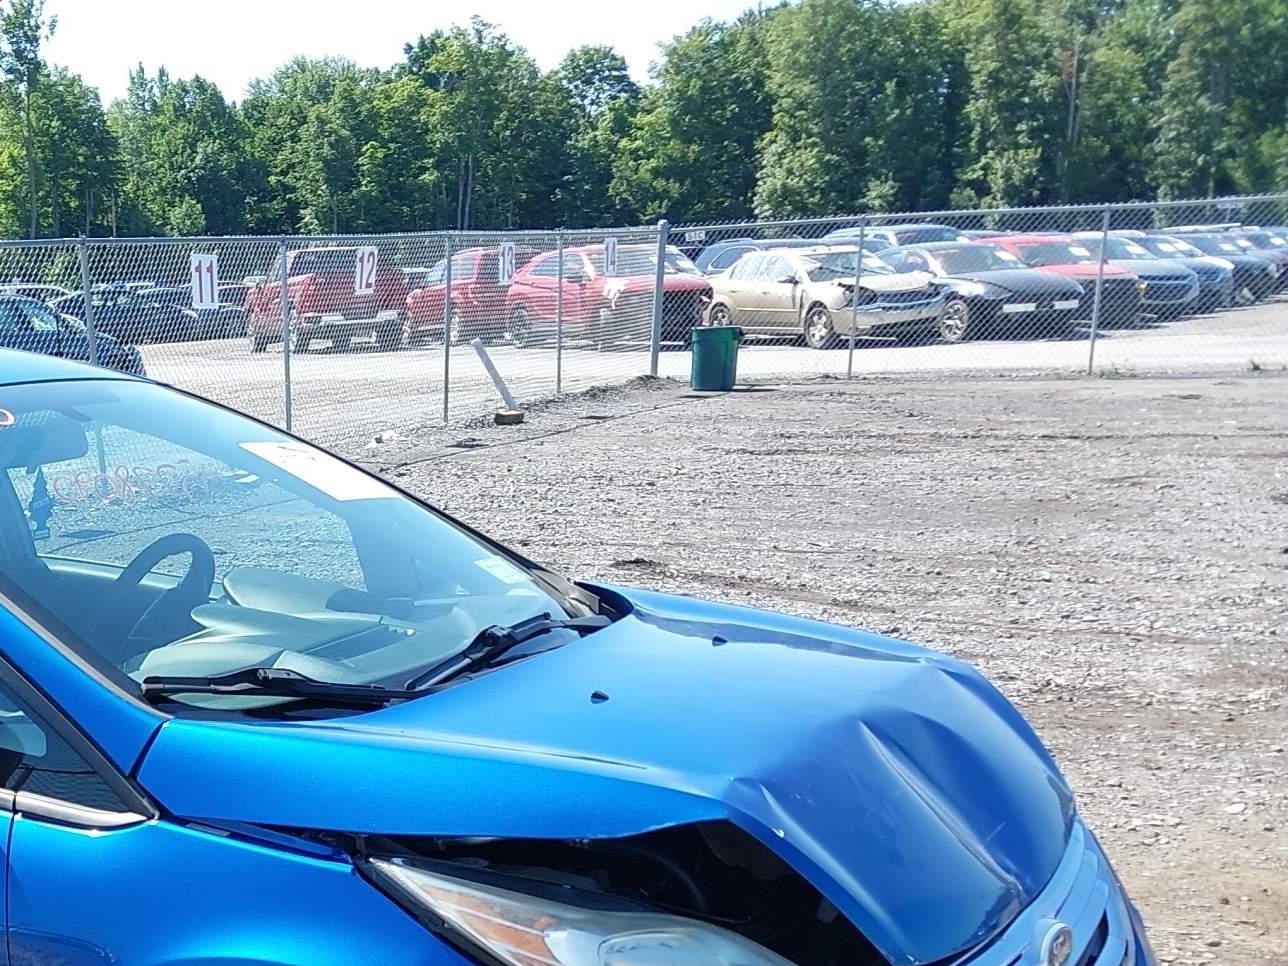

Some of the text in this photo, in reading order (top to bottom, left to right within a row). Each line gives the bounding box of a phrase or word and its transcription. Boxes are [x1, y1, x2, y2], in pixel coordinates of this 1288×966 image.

[194, 259, 214, 303] 11
[358, 251, 376, 290] 12
[500, 245, 513, 279] 13
